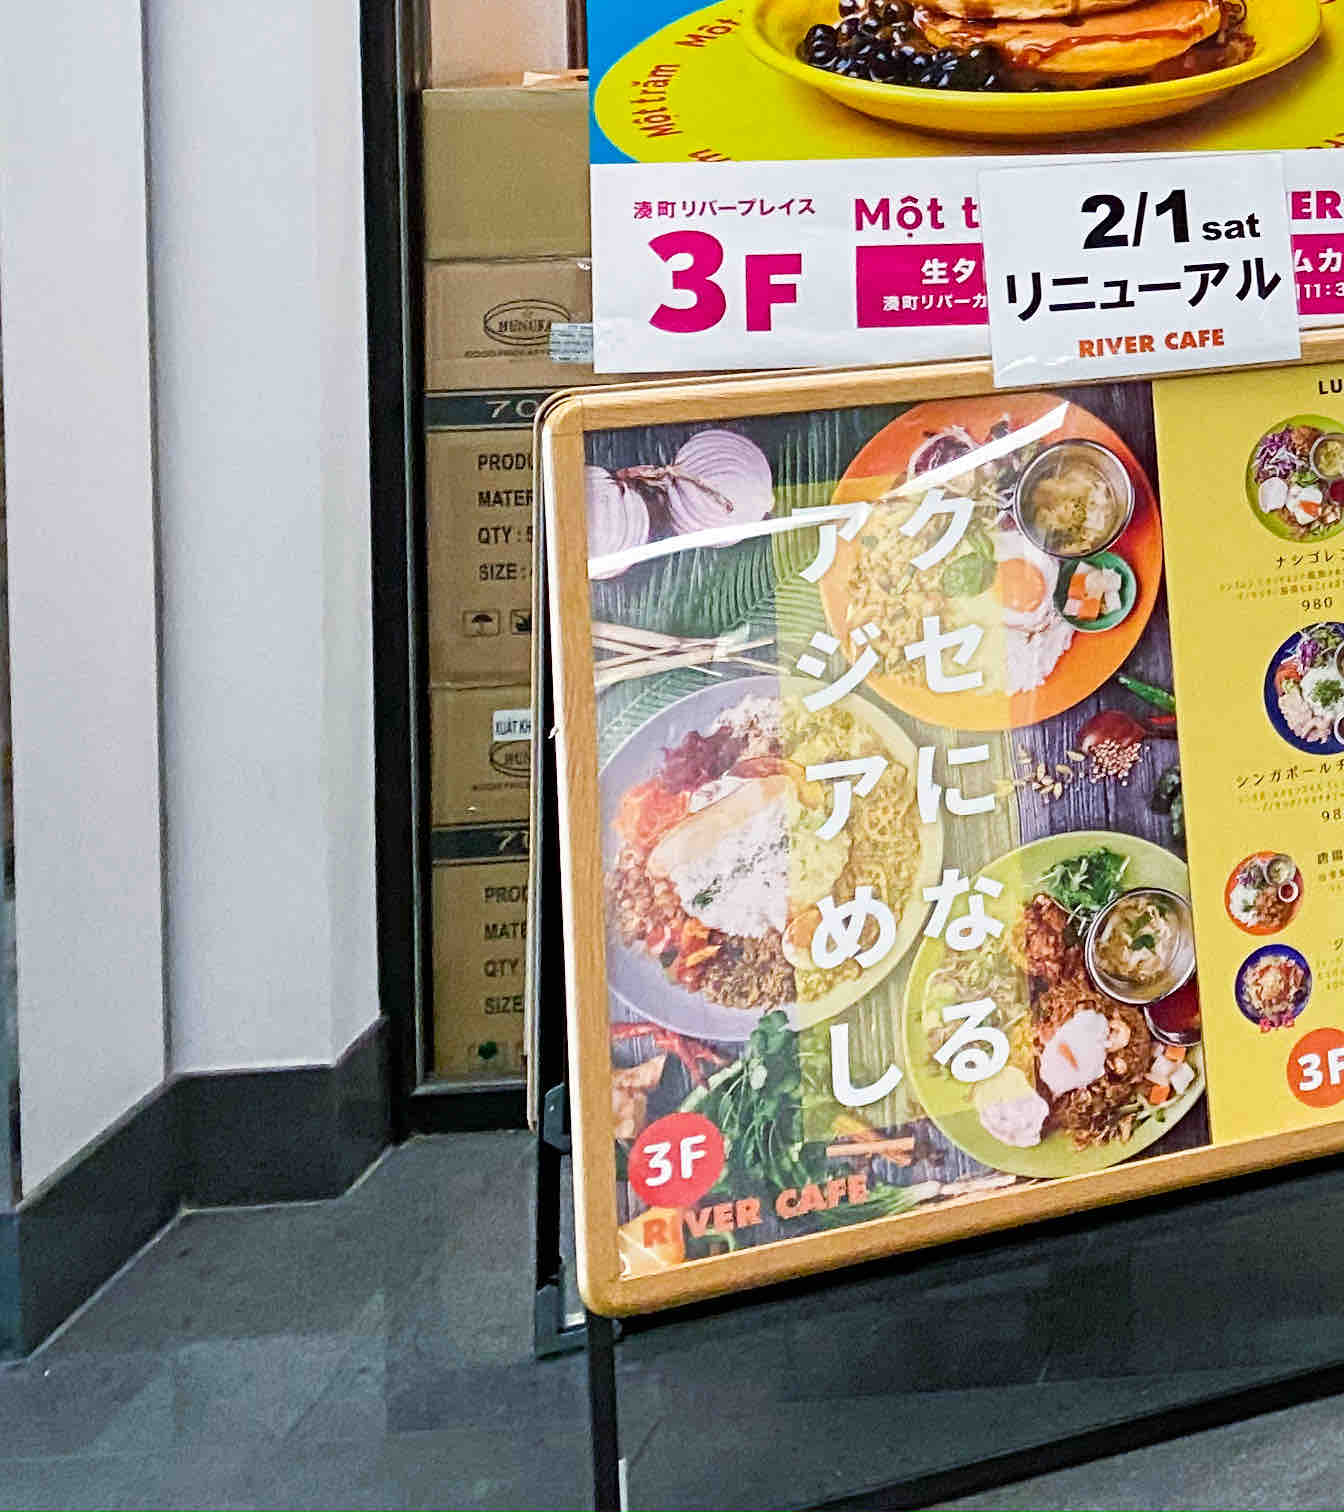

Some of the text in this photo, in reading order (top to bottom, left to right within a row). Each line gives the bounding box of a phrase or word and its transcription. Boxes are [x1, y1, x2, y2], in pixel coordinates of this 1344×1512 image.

[1081, 189, 1261, 250] 2/1 sat
[647, 230, 802, 334] 3F
[1006, 257, 1282, 322] リニューアル
[1078, 328, 1225, 359] RIVER CAFE
[643, 1135, 708, 1187] 3F
[775, 1174, 870, 1221] CAFE
